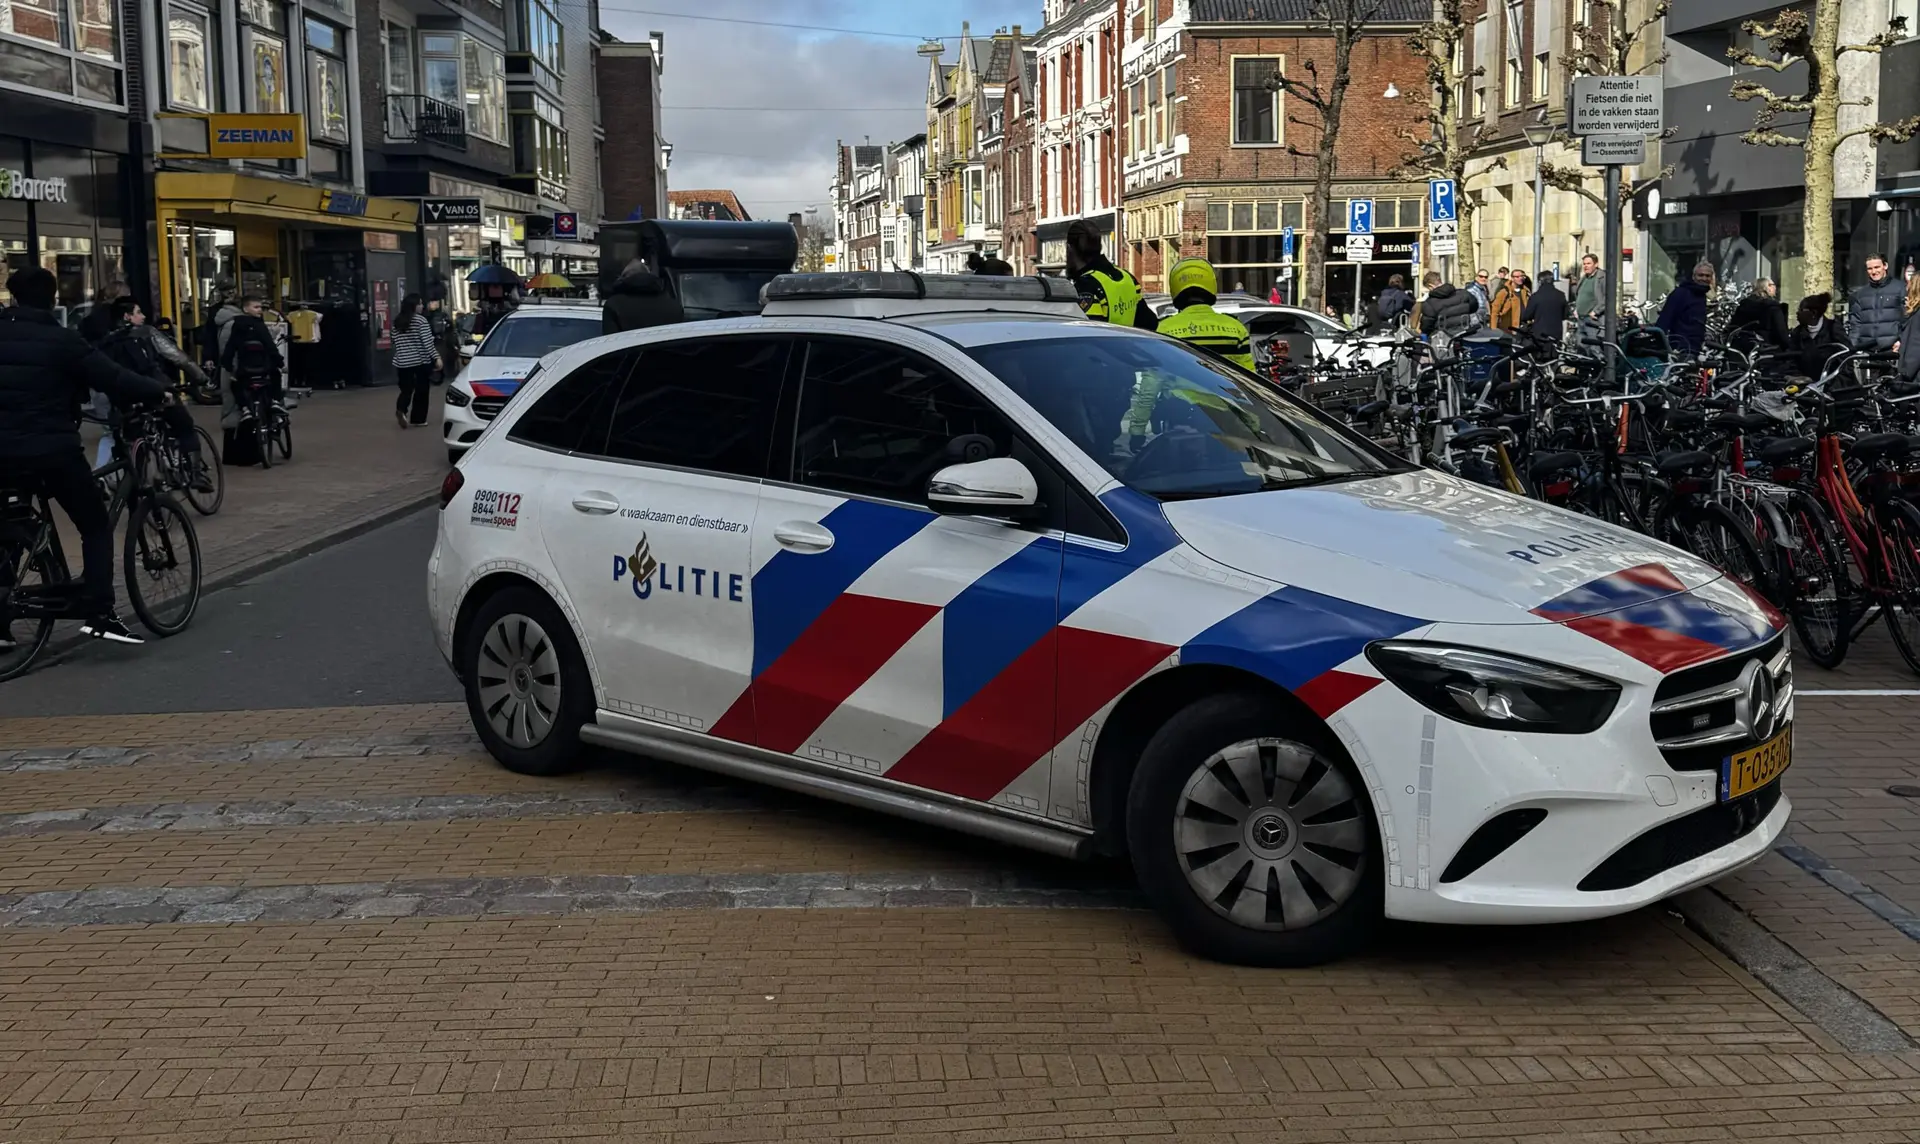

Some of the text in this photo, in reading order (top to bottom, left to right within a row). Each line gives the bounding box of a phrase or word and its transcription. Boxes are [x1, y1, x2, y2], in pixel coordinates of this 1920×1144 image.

[1599, 80, 1634, 90] Attentie
[1586, 93, 1652, 103] Fietsen die niet
[1578, 107, 1659, 117] in de vakken staan
[1578, 119, 1659, 131] worden verwijderd
[217, 129, 293, 143] ZEEMAN
[1591, 140, 1606, 148] Fiets
[12, 170, 68, 203] Barrett
[1436, 182, 1450, 205] P
[445, 205, 479, 215] VAN OS
[1354, 202, 1368, 220] P
[1382, 244, 1413, 253] BEANS
[475, 489, 498, 503] 0900
[472, 502, 494, 515] 8844
[497, 493, 521, 514] 112
[493, 515, 518, 528] spoed
[627, 508, 675, 524] waakzaam
[676, 514, 689, 526] en
[689, 513, 741, 533] dienstbaar
[1506, 532, 1627, 565] POLITIE
[613, 554, 743, 603] POLITIE
